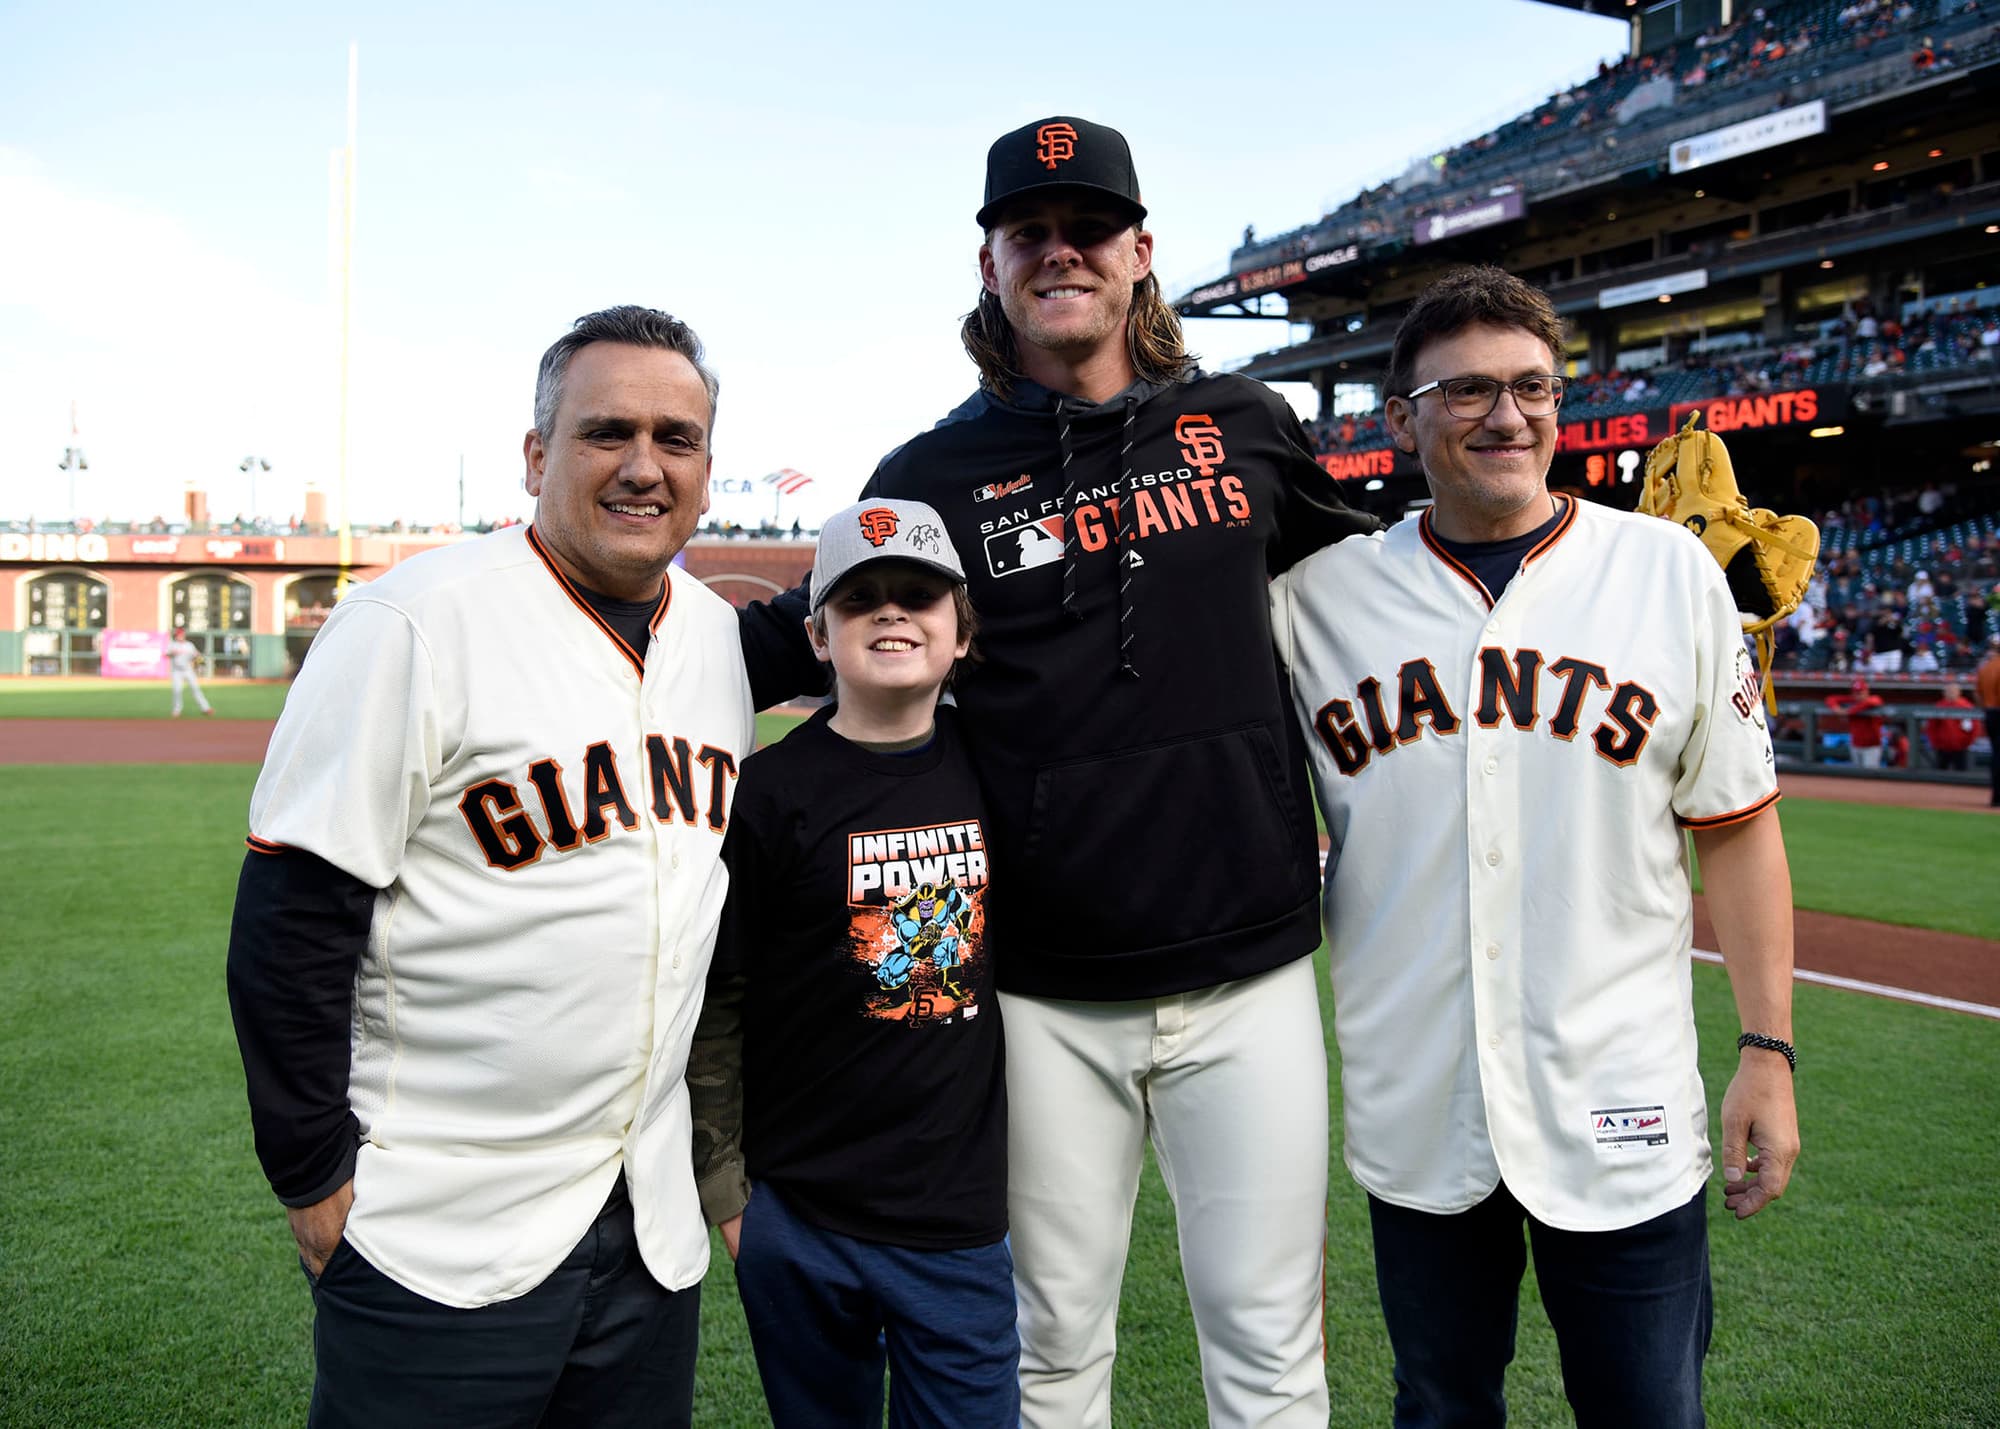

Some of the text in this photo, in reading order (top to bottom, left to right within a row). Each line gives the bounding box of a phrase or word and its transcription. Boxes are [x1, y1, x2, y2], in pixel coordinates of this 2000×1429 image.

[1036, 123, 1079, 170] SF
[1305, 245, 1359, 272] ORACLE
[1191, 280, 1238, 304] ORACLE
[1707, 390, 1818, 432] GIANTS
[1175, 414, 1226, 476] SF
[1557, 413, 1648, 452] HILLIES
[1326, 449, 1394, 480] GIANTS
[859, 507, 900, 547] SF
[980, 508, 1030, 534] SAN
[1314, 646, 1661, 777] GIANTS
[458, 734, 739, 872] GIANT
[852, 823, 984, 865] INFINITE
[852, 850, 988, 902] POWER
